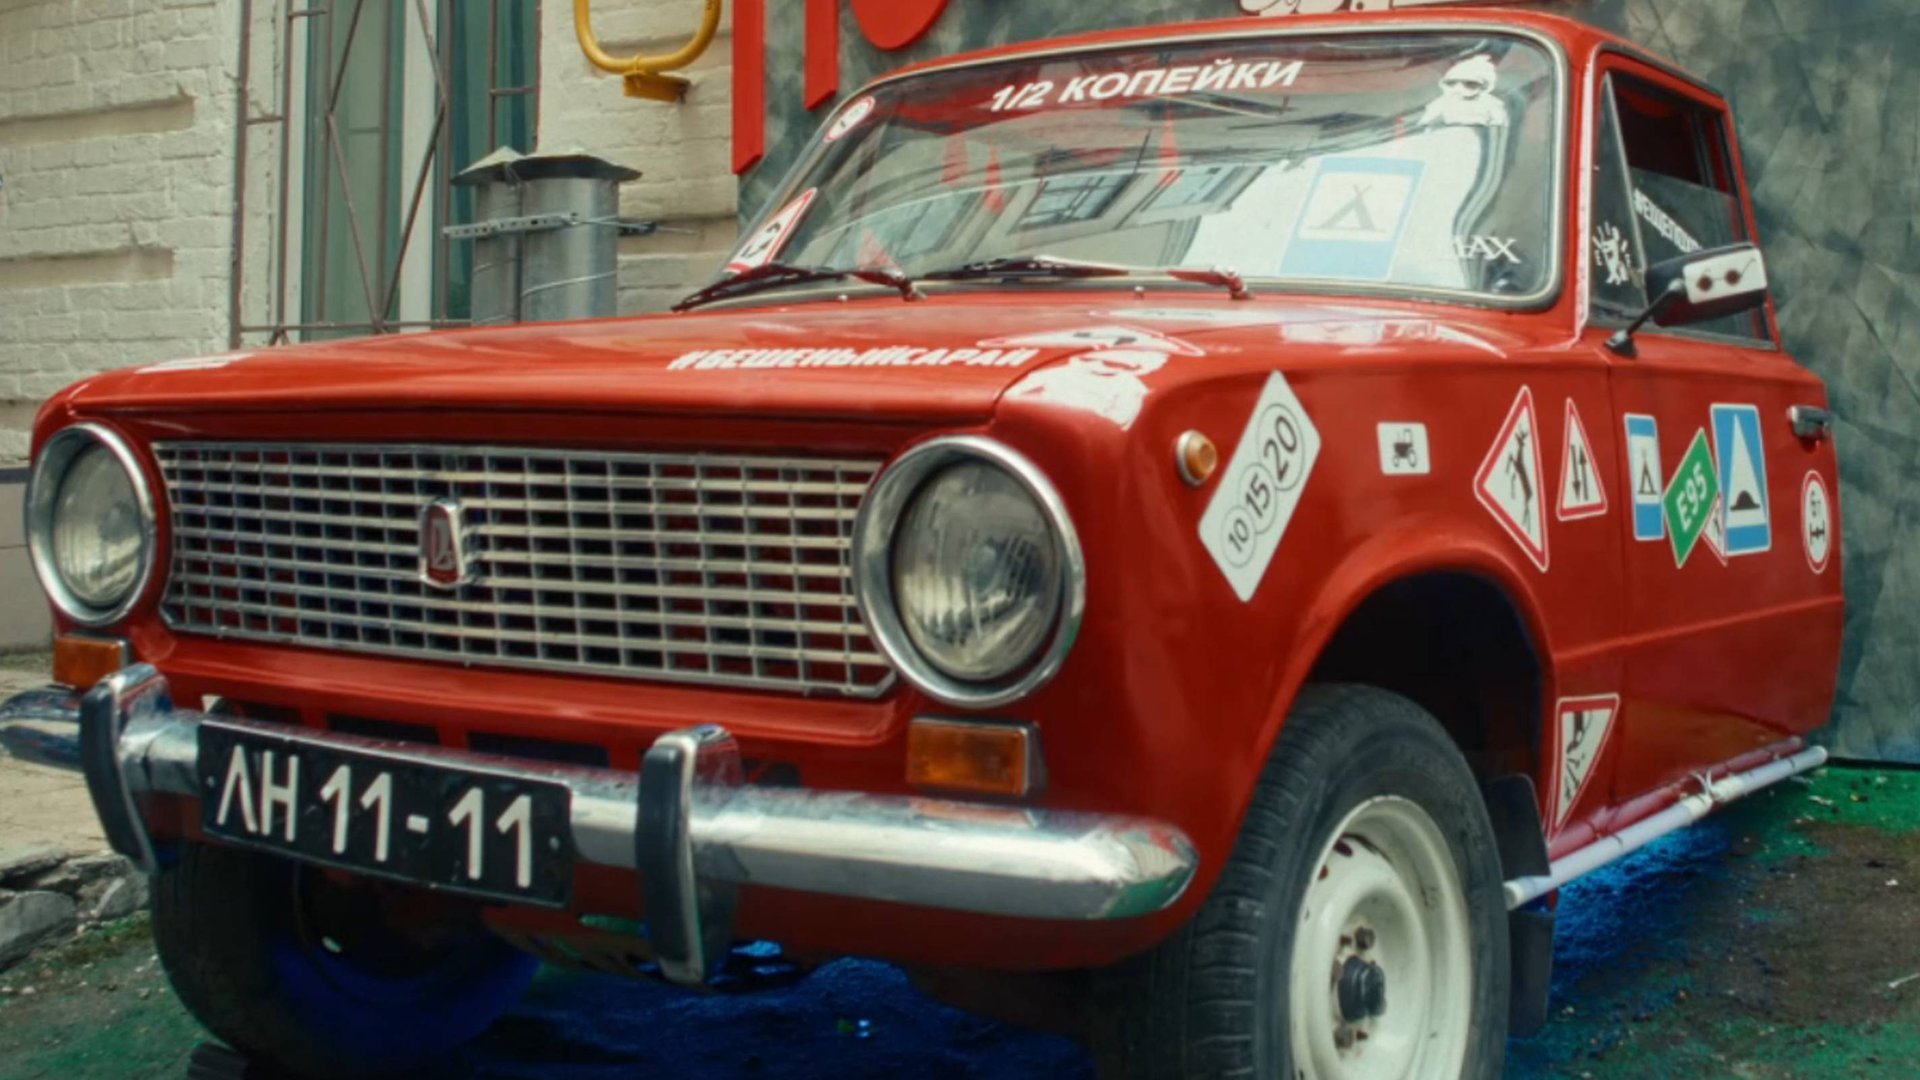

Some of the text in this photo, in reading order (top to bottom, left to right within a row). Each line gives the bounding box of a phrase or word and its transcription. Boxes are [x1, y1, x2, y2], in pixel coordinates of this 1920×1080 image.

[989, 56, 1304, 112] 1/2 КОПЕЙКИ
[1227, 414, 1299, 553] 10 15 20
[1675, 461, 1708, 533] E95
[216, 743, 532, 890] ЛН 11-11
